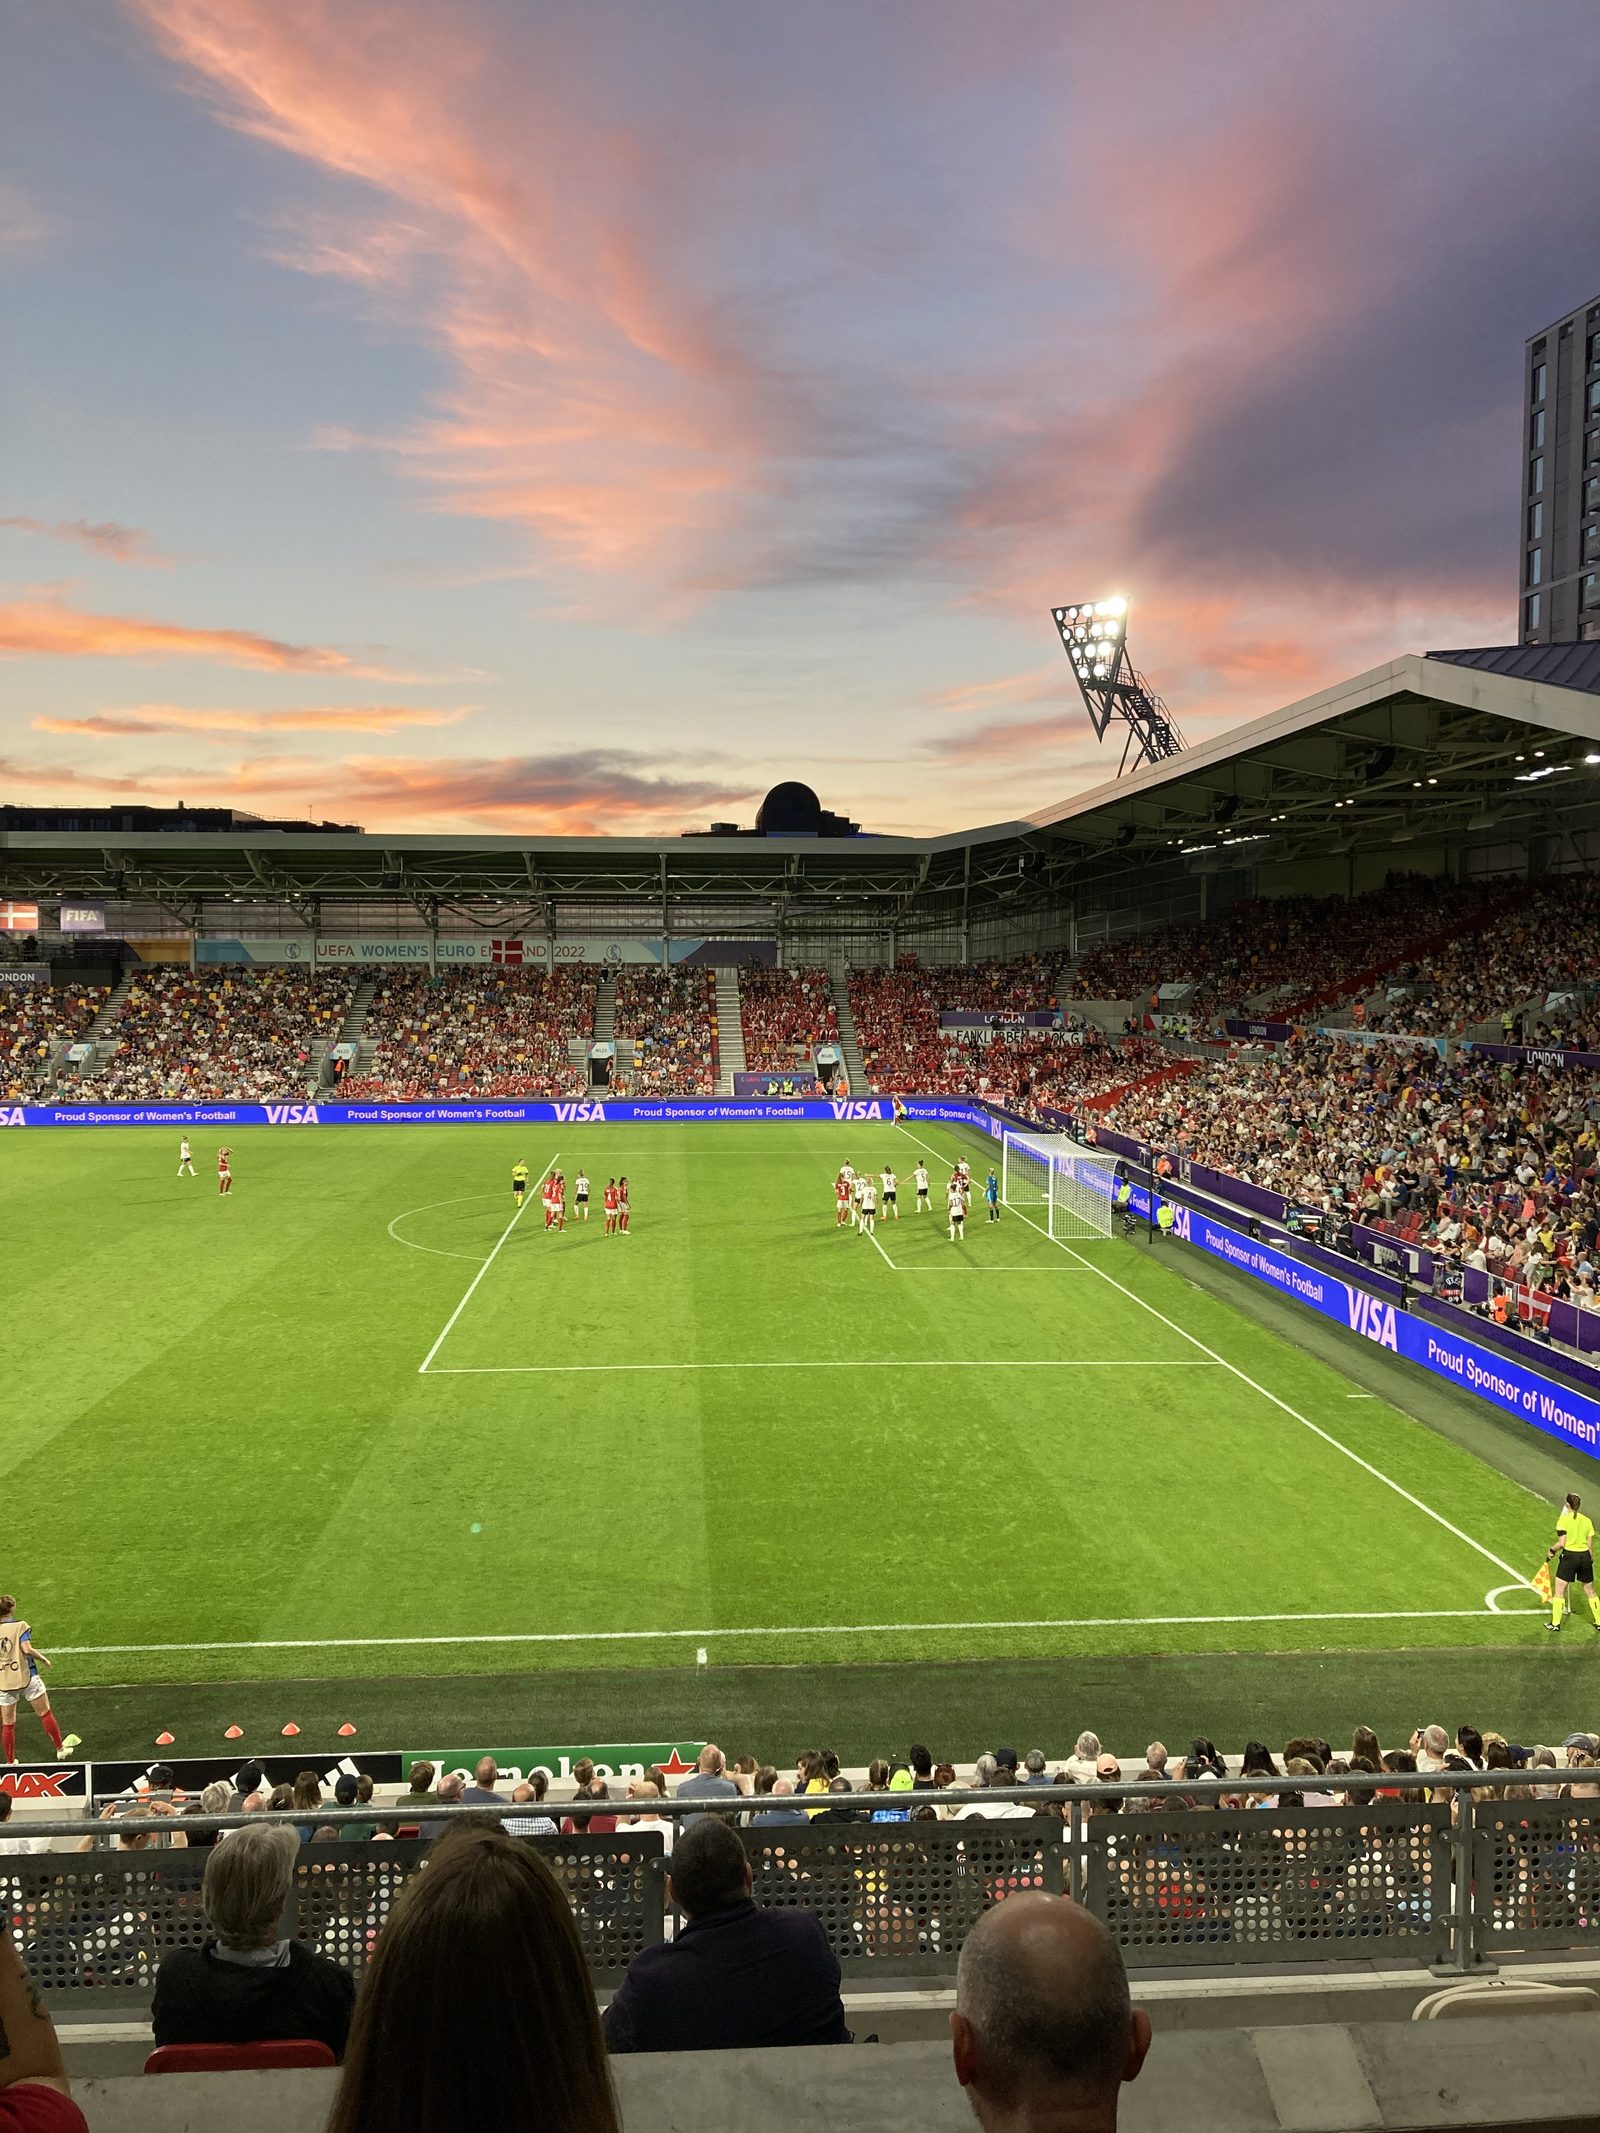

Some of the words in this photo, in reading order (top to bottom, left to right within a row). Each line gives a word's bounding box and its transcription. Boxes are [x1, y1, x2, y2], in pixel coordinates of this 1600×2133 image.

[66, 910, 98, 921] FIFA
[317, 945, 355, 957] UEFA
[361, 945, 429, 957] WOMEN'S
[437, 945, 475, 957] EURO
[480, 945, 547, 957] ENND
[554, 945, 586, 957] 2022
[957, 1030, 1028, 1044] FANKLBBE
[1527, 1050, 1564, 1067] LONDON
[54, 1112, 85, 1121] Proud
[88, 1112, 131, 1123] Sponsor
[133, 1112, 145, 1121] of
[146, 1112, 192, 1121] Women's
[195, 1111, 236, 1120] Football
[261, 1105, 319, 1124] VISA
[347, 1110, 378, 1119] Proud
[380, 1110, 422, 1121] Sponsor
[424, 1110, 435, 1119] of
[437, 1109, 483, 1119] Women's
[485, 1109, 525, 1118] Football
[550, 1103, 606, 1122] VISA
[633, 1108, 663, 1117] Proud
[665, 1108, 706, 1118] Sponsor
[708, 1107, 719, 1117] of
[720, 1107, 764, 1116] Women's
[766, 1107, 804, 1116] Football
[828, 1101, 882, 1120] VISA
[908, 1107, 937, 1116] Proud
[939, 1108, 966, 1119] Sponsor
[886, 1177, 892, 1186] 6
[921, 1173, 926, 1182] 5
[840, 1186, 846, 1196] 3
[867, 1191, 872, 1200] 4
[953, 1197, 961, 1207] 17
[1167, 1200, 1191, 1242] ISA
[1206, 1229, 1224, 1249] Proud
[1224, 1238, 1250, 1264] Sponsor
[1251, 1253, 1259, 1268] of
[1258, 1255, 1291, 1286] Women's
[1292, 1272, 1323, 1303] Football
[1344, 1283, 1398, 1353] VISA
[1428, 1338, 1464, 1375] Proud
[1466, 1357, 1521, 1404] Sponsor
[1523, 1390, 1538, 1413] of
[410, 1756, 645, 1784] Heneken
